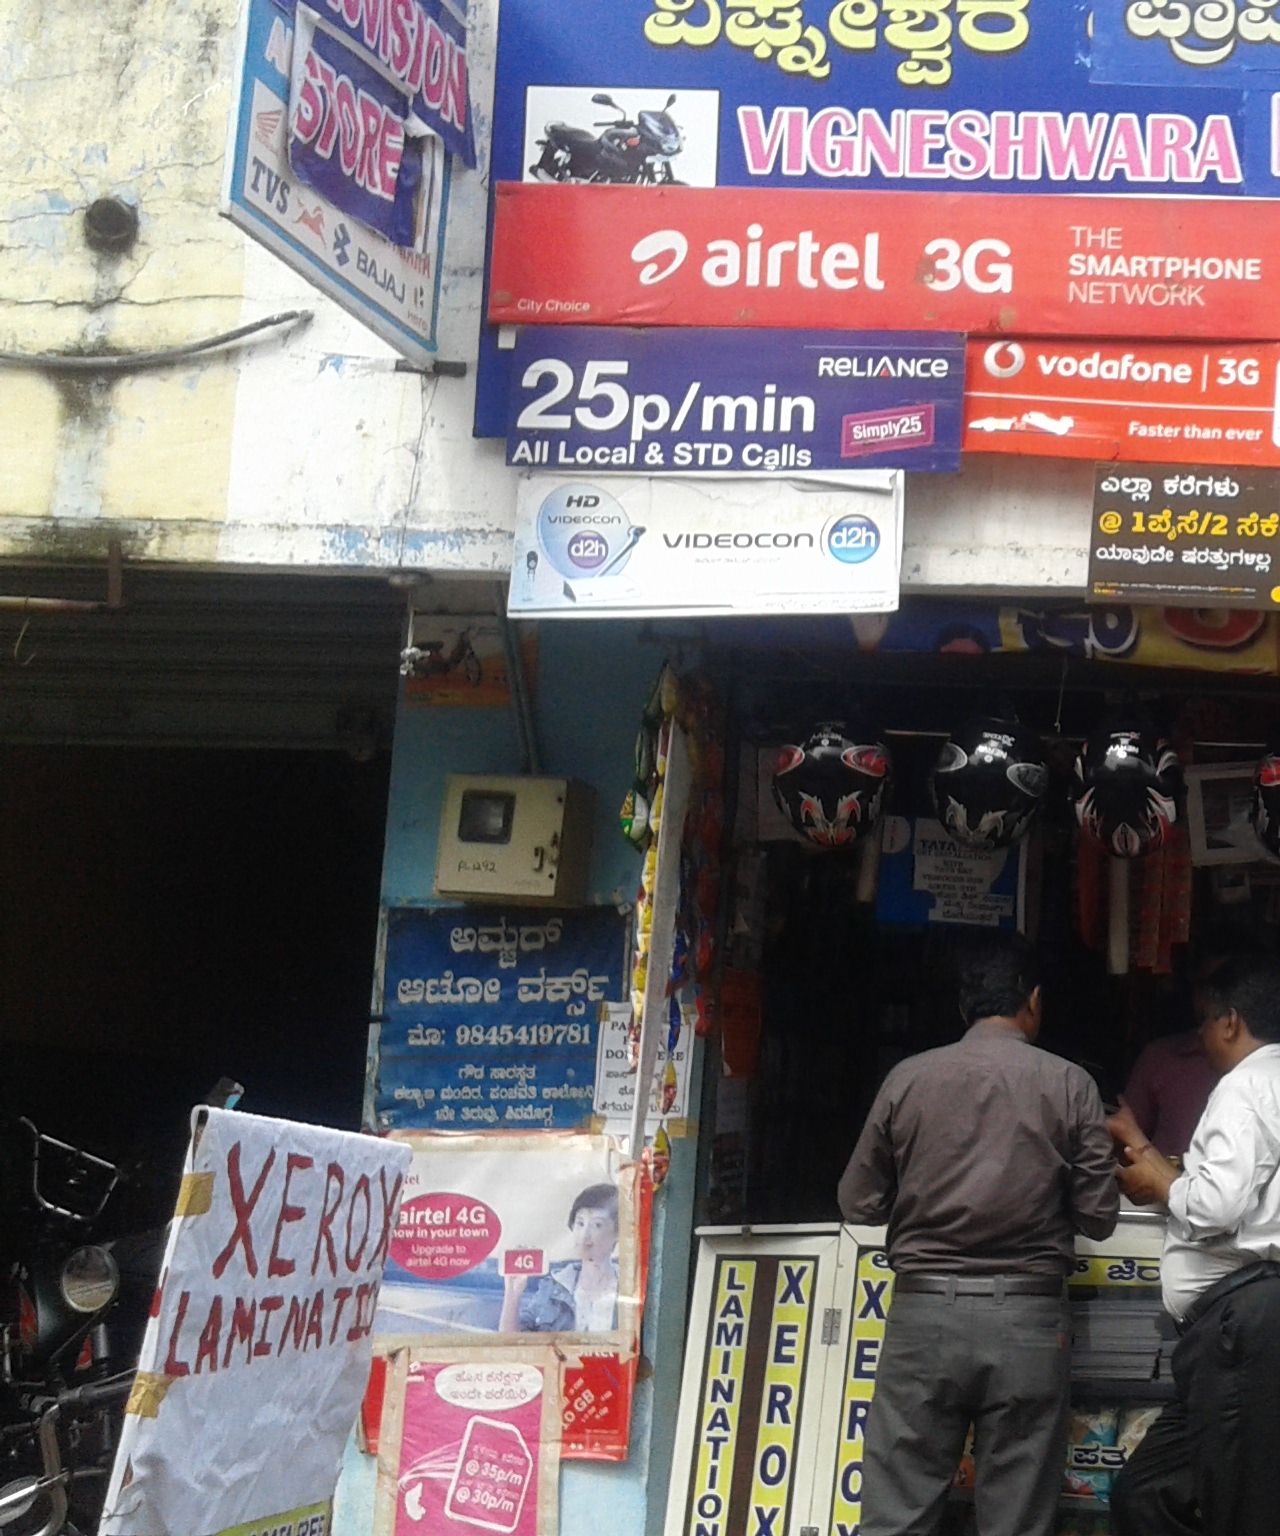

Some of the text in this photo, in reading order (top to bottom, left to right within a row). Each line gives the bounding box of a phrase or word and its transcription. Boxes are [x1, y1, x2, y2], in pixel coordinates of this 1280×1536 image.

[294, 49, 404, 202] STORE
[737, 106, 1243, 183] VIGNESHWARA
[252, 156, 290, 215] TVS
[1069, 226, 1122, 250] THE
[702, 223, 1013, 294] airtel 3G
[1068, 254, 1262, 281] SMARTPHONE
[517, 298, 591, 314] City Choice
[1068, 281, 1206, 307] NETWORK
[1037, 352, 1260, 386] vodafone 3G
[517, 359, 816, 441] 25p/min
[1128, 421, 1263, 442] Faster than ever
[511, 440, 812, 467] All Local & STD Calls
[565, 494, 600, 508] HD
[546, 514, 622, 525] VIDEOCON
[570, 536, 607, 558] d2h
[662, 526, 876, 550] VIDEOCON d2h
[456, 1024, 590, 1046] 9845419781
[213, 1140, 404, 1279] XEROX
[398, 1206, 486, 1225] airtel 4G
[417, 1227, 428, 1239] in
[431, 1228, 457, 1241] your
[459, 1227, 489, 1239] town
[411, 1244, 466, 1256] Upgrade to
[406, 1257, 470, 1268] airtel 4G now
[514, 1255, 534, 1271] 4G
[164, 1280, 380, 1377] LAMINATIO
[696, 1267, 745, 1536] LAMINATION
[754, 1265, 808, 1536] XEROX
[481, 1461, 523, 1486] 35p/m
[471, 1488, 514, 1512] 30p/m
